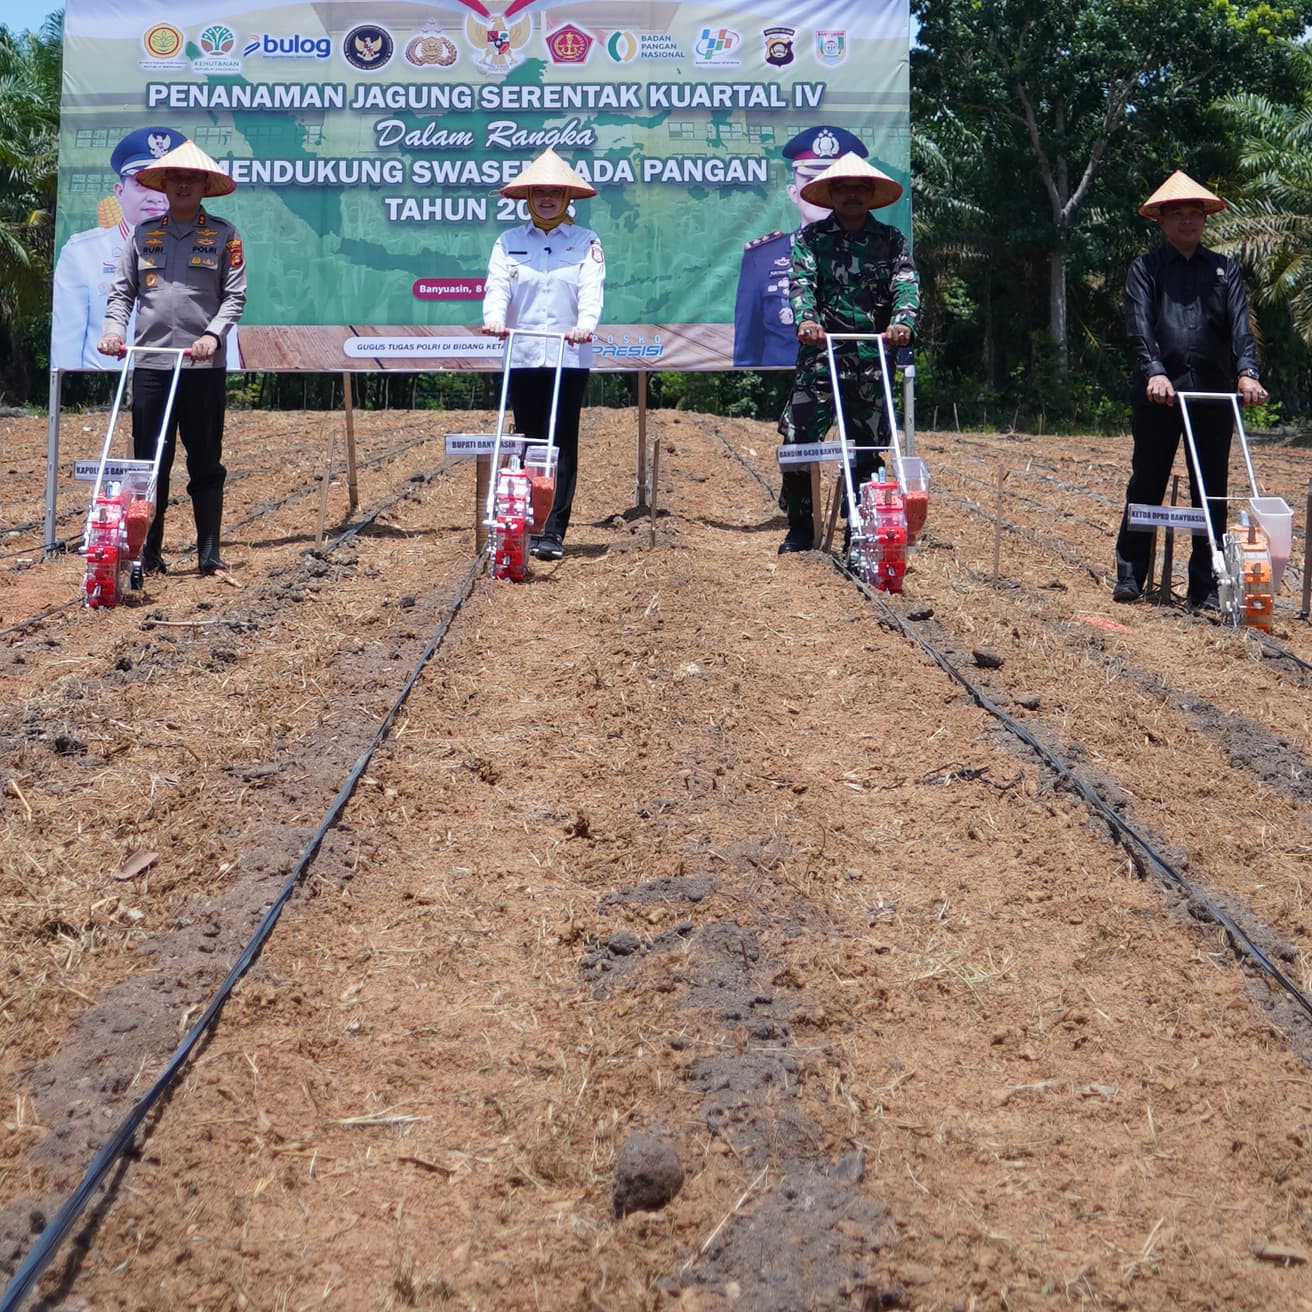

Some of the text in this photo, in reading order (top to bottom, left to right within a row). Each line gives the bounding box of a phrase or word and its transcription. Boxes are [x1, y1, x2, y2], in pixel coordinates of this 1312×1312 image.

[263, 34, 331, 58] bulog
[149, 84, 824, 109] PENANAMAN JAGUNG SERENTAK KUARTAL IV
[376, 119, 595, 149] Dalam Rangka
[412, 160, 635, 184] SWASEADA
[643, 159, 768, 182] PANGAN
[385, 198, 576, 221] TAHUN 20
[192, 246, 217, 255] POLRI
[419, 284, 472, 295] Banyuasin,
[356, 343, 387, 351] GUGUS
[389, 343, 415, 351] TUGAS
[416, 343, 441, 351] POLRI
[451, 440, 516, 449] BUPATI BANYASIN
